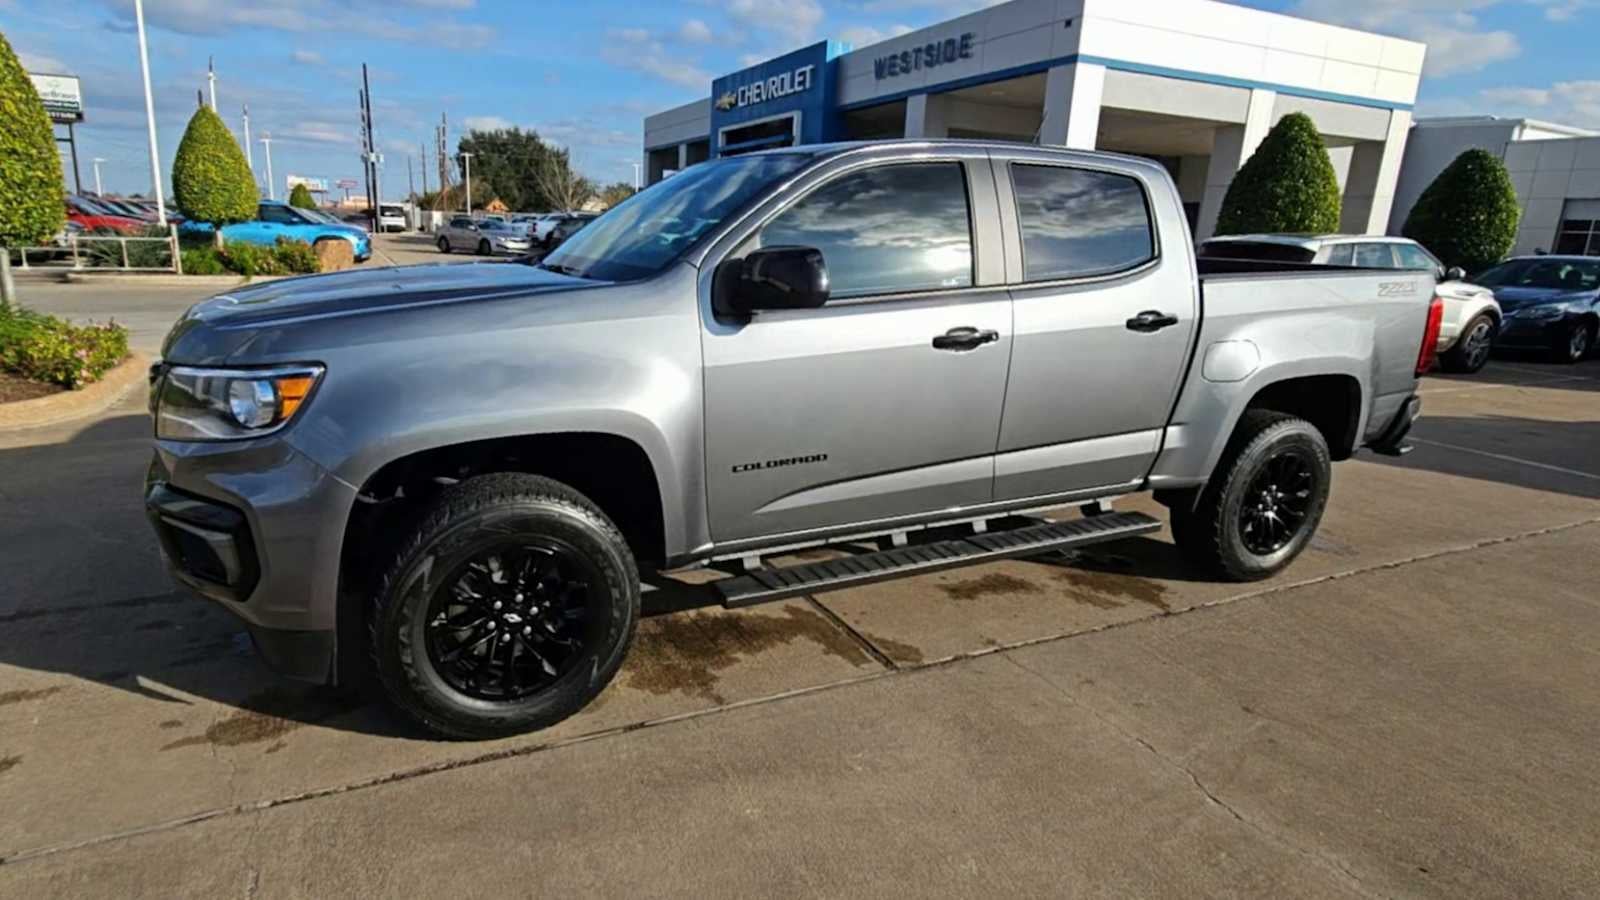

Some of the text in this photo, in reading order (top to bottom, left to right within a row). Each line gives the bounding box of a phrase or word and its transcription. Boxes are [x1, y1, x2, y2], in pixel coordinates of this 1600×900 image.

[874, 32, 975, 80] WESTSIDE
[738, 64, 815, 106] CHEVROLET
[732, 454, 828, 472] COLORADO
